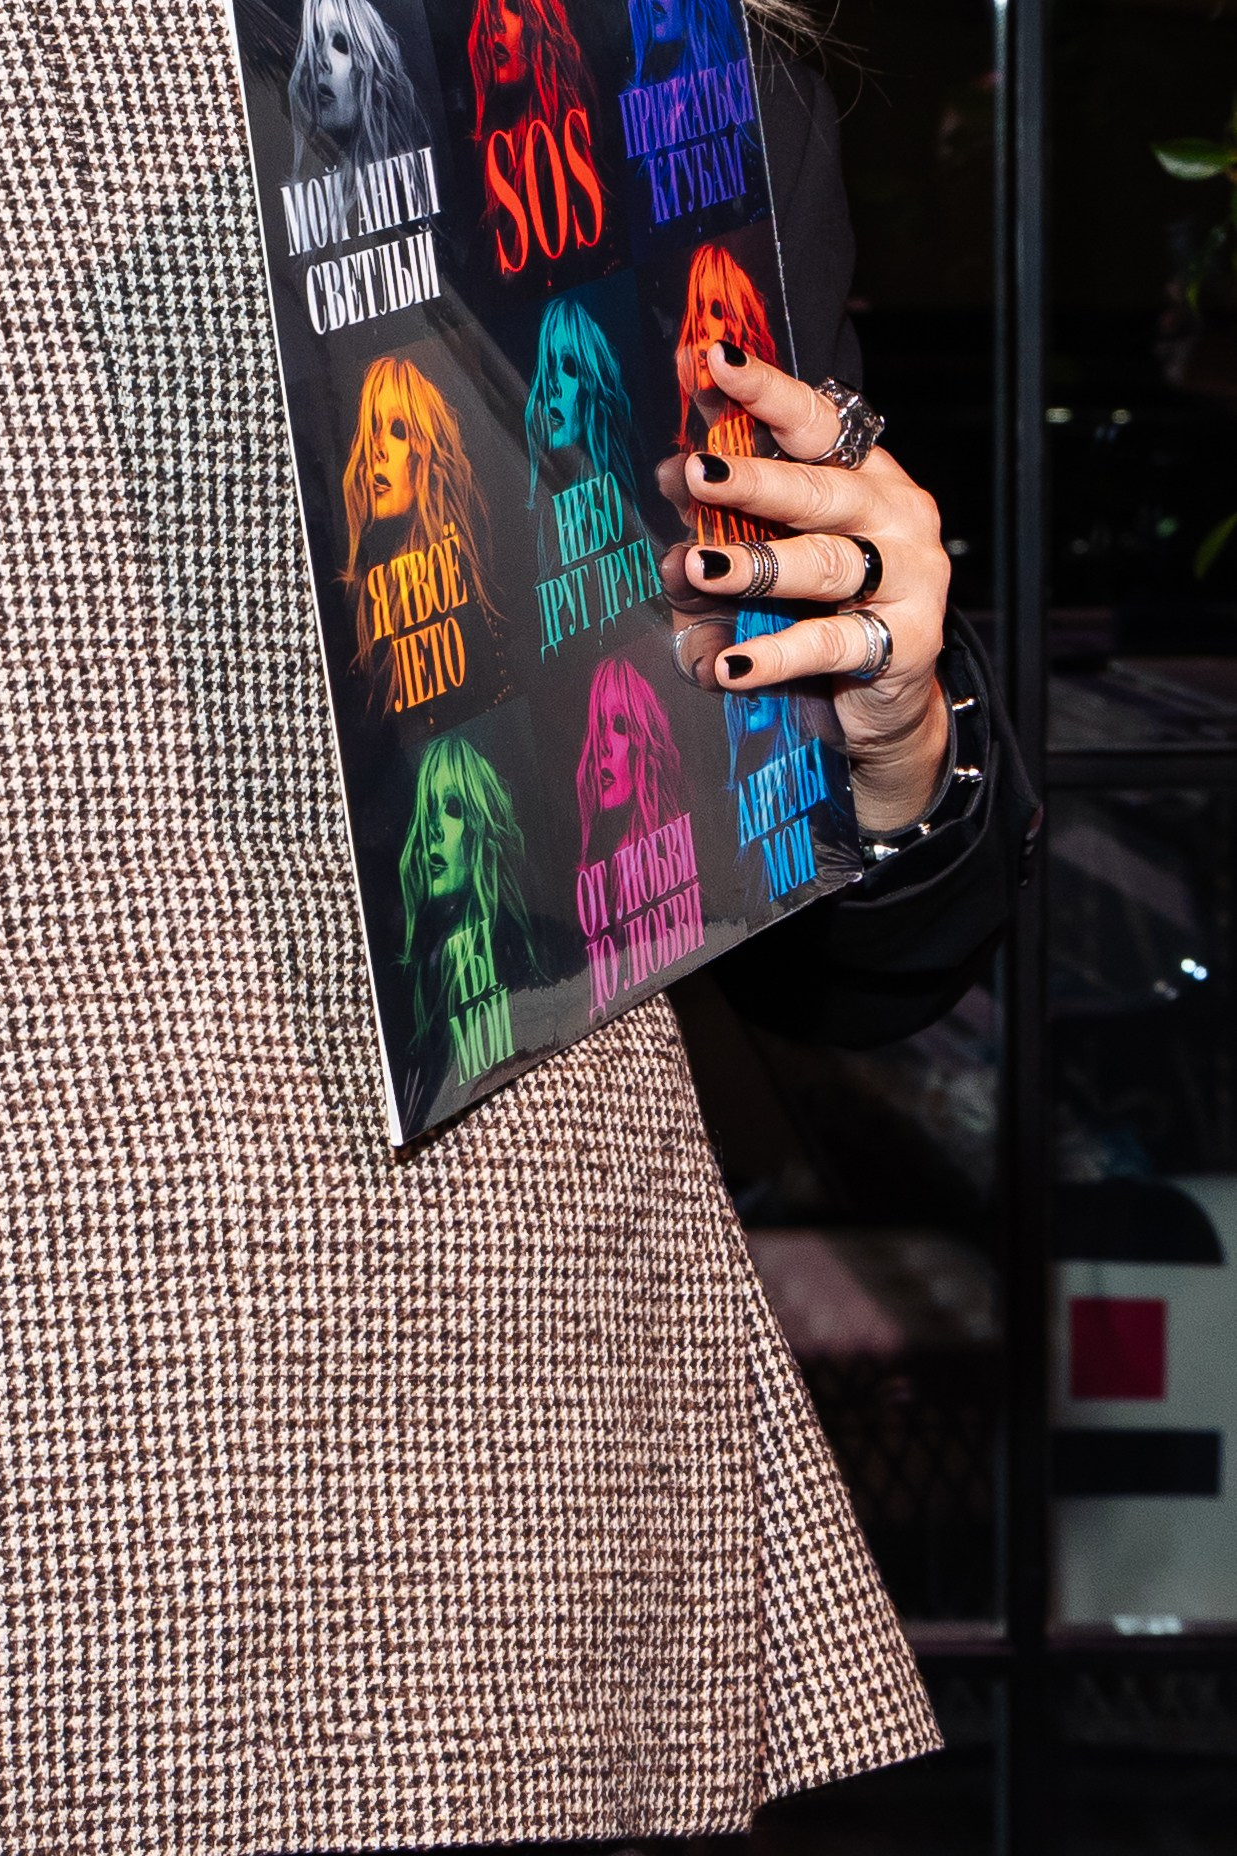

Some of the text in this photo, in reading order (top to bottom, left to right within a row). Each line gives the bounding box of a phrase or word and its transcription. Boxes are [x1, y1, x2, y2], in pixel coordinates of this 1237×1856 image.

[618, 58, 756, 160] ПРИЖАТЬСЯ
[280, 146, 441, 257] МОЙ АНГЕЛ
[486, 108, 603, 275] SOS
[306, 223, 442, 336] СВЕТЛЫЙ
[551, 471, 624, 568] НЕБО
[367, 521, 469, 642] Я ТВОЁ
[535, 536, 663, 665] ДРУГ ДРУГА
[392, 616, 466, 714] ЛЕТО
[737, 736, 827, 848] АНГЕЛЫ
[576, 811, 699, 938] ОТ ЛЮБВИ
[447, 917, 499, 1005] ТЫ
[586, 881, 705, 1025] ДО ЛЮБВИ
[449, 983, 516, 1087] МОЙ
